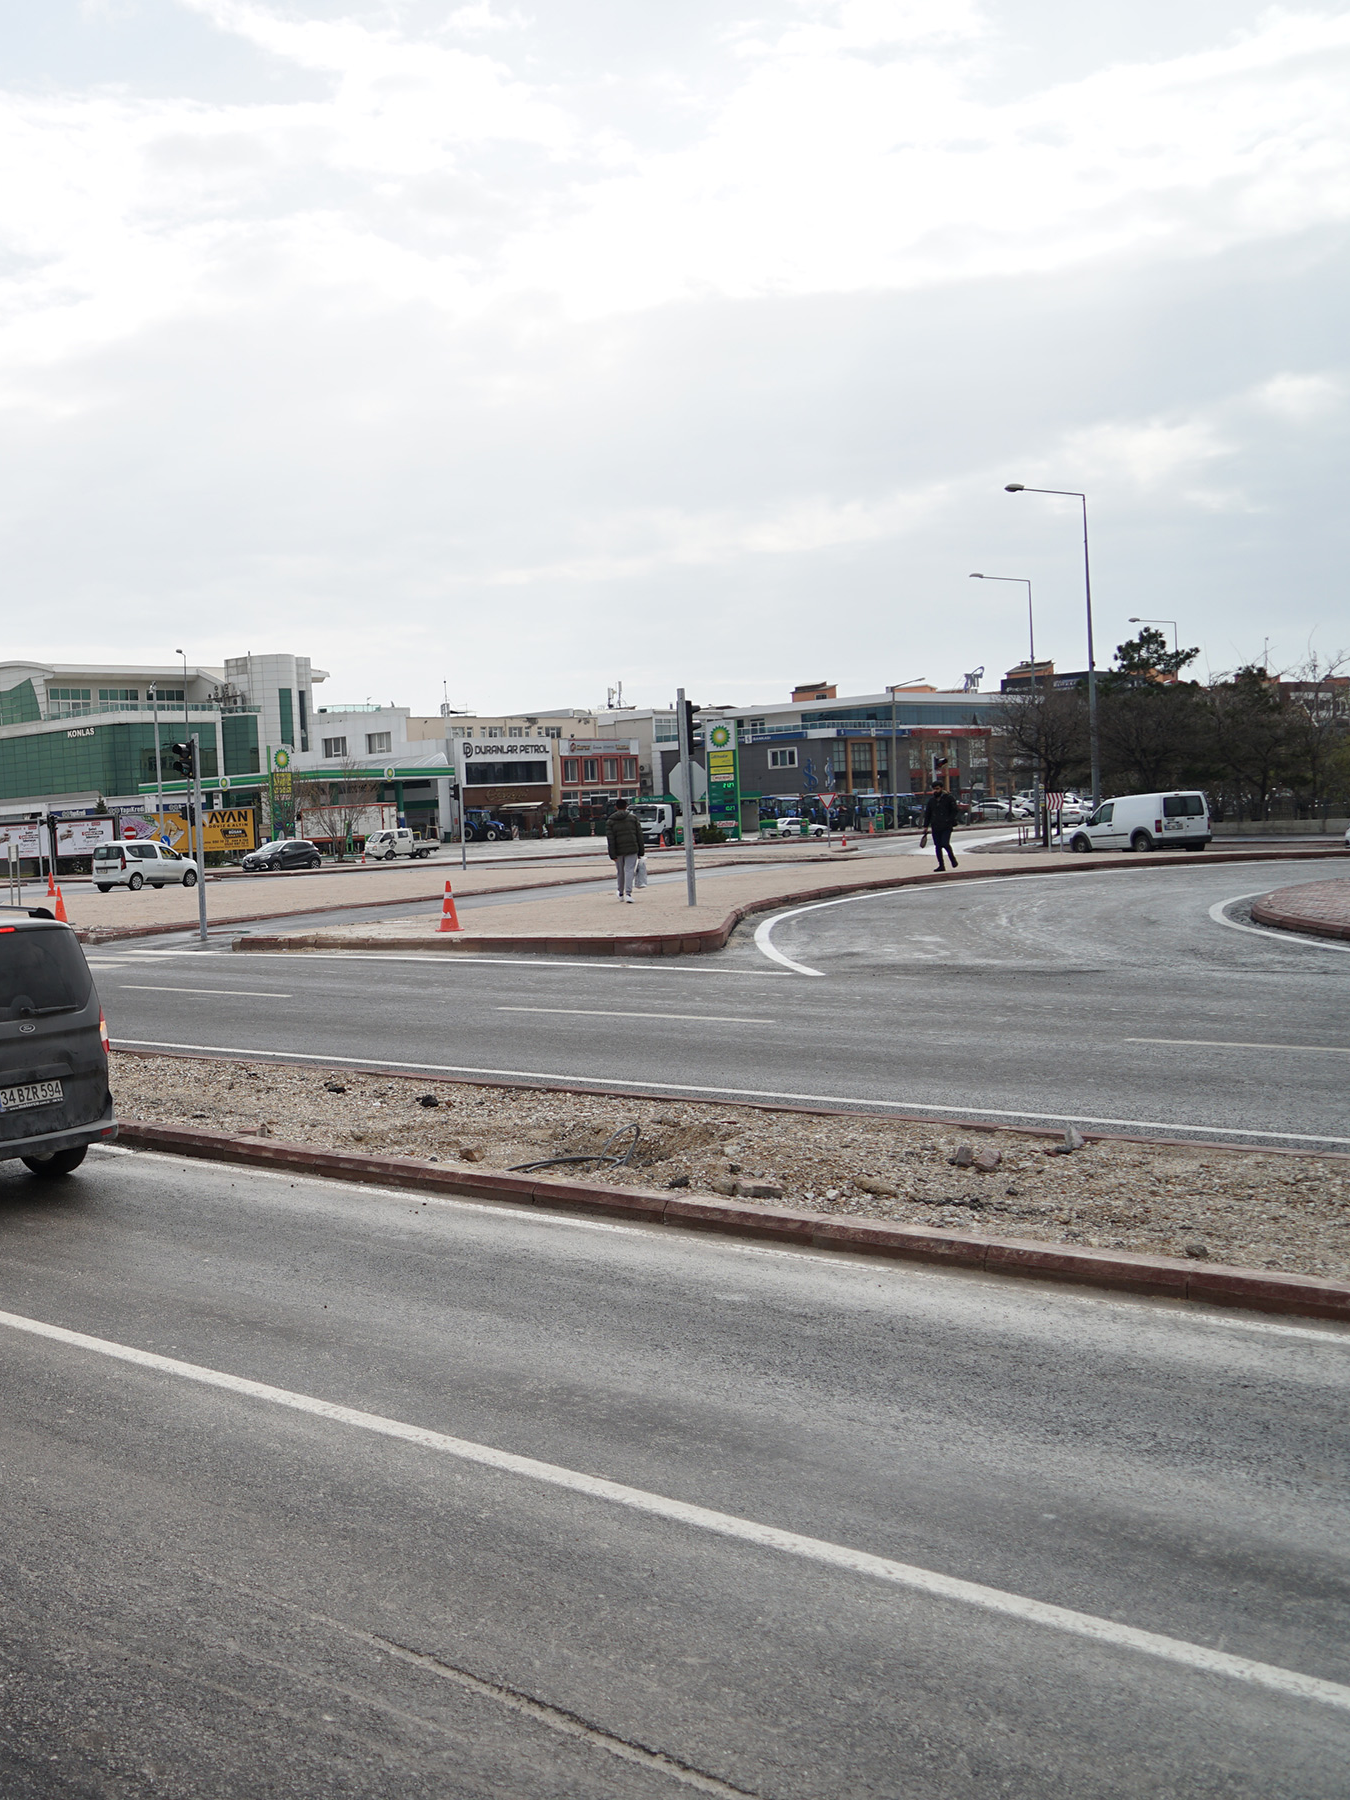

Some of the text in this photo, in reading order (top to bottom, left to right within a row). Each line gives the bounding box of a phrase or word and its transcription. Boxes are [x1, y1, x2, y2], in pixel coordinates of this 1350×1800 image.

[67, 727, 95, 738] KONLAS
[474, 744, 550, 755] DURANLAR PETROL
[209, 811, 248, 824] AYAN
[0, 1081, 62, 1105] 34 BZR 594
